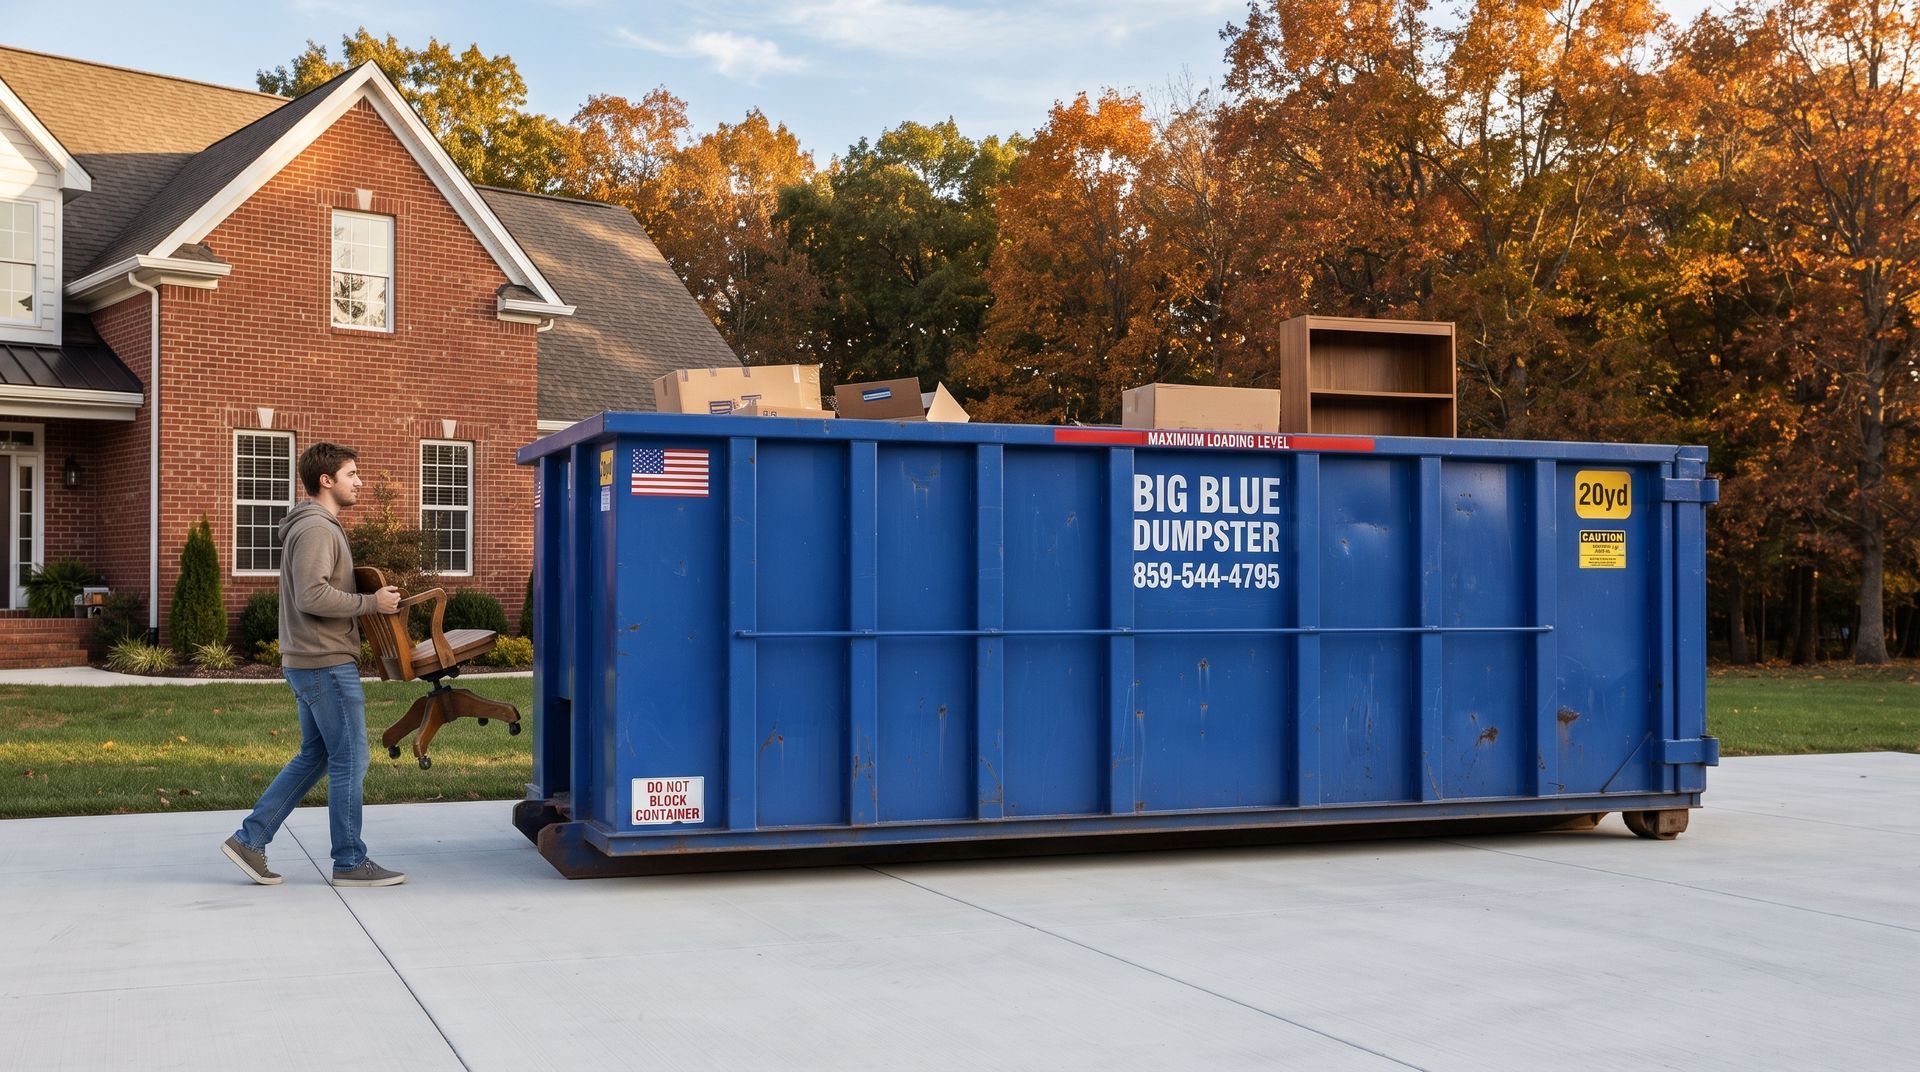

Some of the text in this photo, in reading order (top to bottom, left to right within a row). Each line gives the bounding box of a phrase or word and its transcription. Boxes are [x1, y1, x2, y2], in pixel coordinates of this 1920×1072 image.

[1148, 432, 1289, 449] MAXIMUM LOADING LEVEL
[1133, 474, 1280, 515] BIG BLUE
[1579, 482, 1628, 511] 20yd
[1133, 520, 1280, 553] DUMPSTER
[1582, 533, 1623, 542] CAUTION
[1133, 562, 1280, 589] 859-544-4795
[647, 780, 690, 793] DO NOT
[650, 794, 687, 807] BLOCK
[635, 808, 700, 821] CONTAINER
